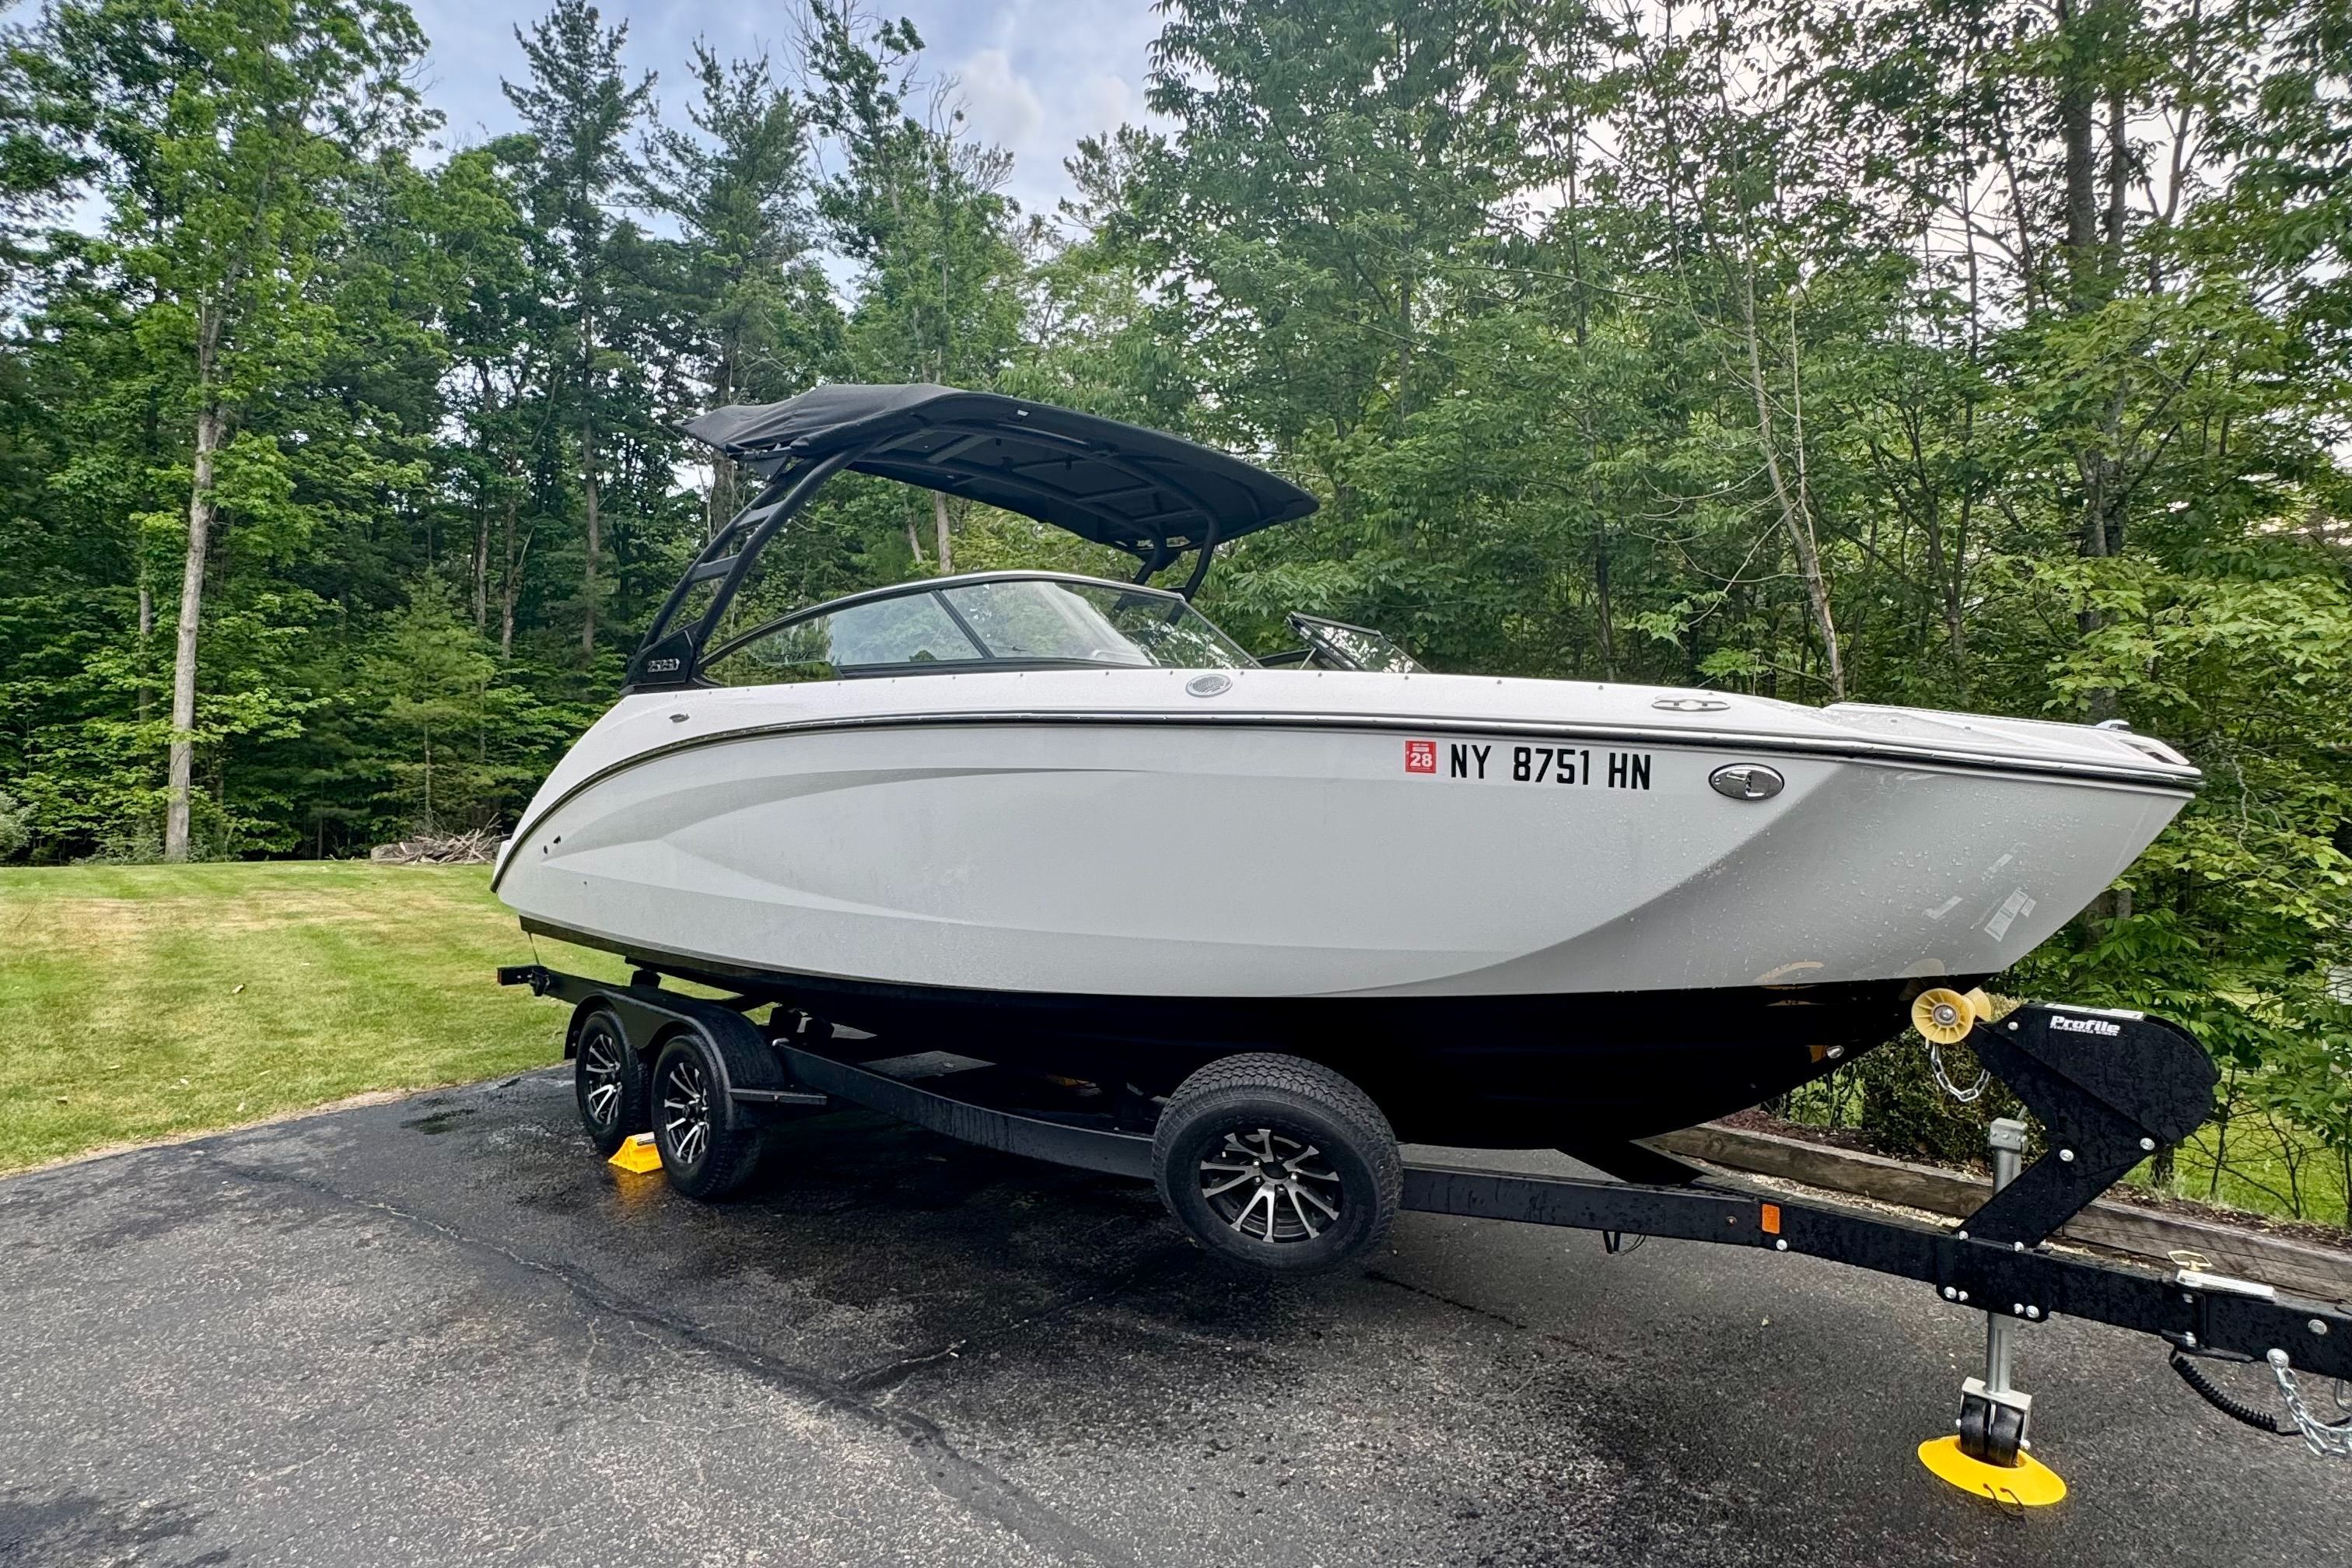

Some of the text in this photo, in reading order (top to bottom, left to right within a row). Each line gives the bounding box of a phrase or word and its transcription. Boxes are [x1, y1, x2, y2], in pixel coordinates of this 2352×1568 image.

[1409, 752, 1433, 768] 28
[1451, 744, 1650, 790] NY 8751 HN
[2049, 1015, 2120, 1033] Profile
